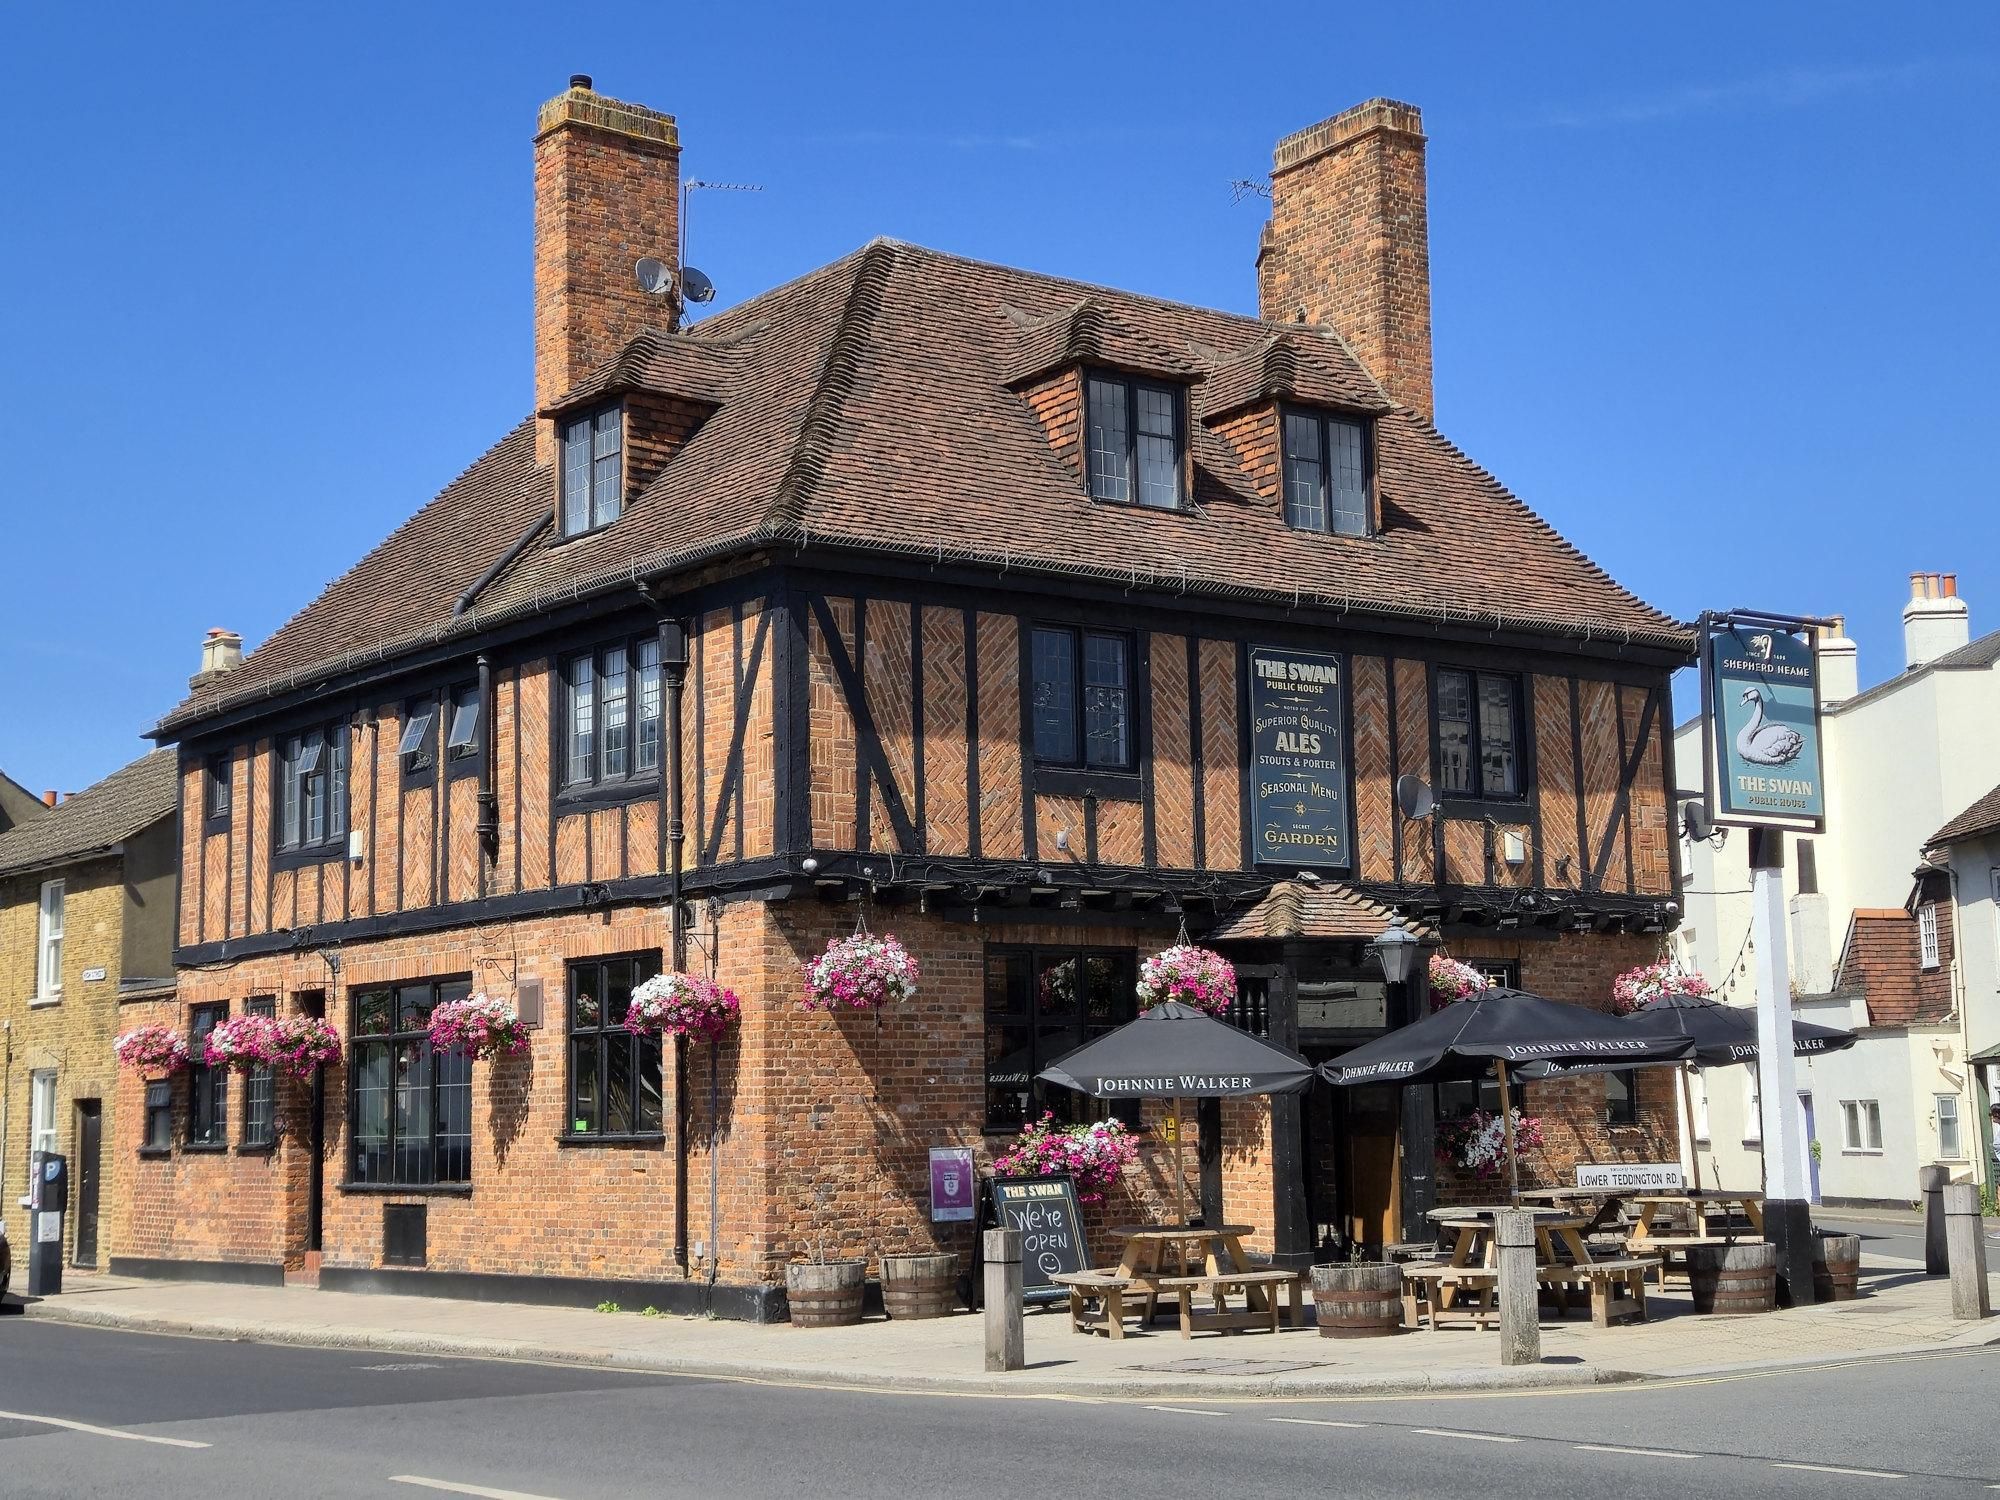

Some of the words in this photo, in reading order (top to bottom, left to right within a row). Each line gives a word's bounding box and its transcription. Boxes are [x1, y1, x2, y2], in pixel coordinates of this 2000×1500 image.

[1254, 658, 1287, 680] THE
[1288, 662, 1337, 685] SWAN
[1723, 660, 1774, 673] SHEPHERD
[1777, 665, 1810, 677] NEAME
[1266, 680, 1296, 691] PUBLIC
[1297, 683, 1324, 694] HOUSE
[1255, 716, 1298, 733] SUPERIOR
[1300, 714, 1338, 737] QUALITY
[1275, 731, 1321, 755] ALES
[1259, 755, 1292, 766] STOUTS
[1293, 758, 1301, 767] &
[1303, 758, 1336, 770] PORTER
[1260, 782, 1308, 798] SEASONAL
[1311, 781, 1338, 801] MENU
[1737, 775, 1766, 792] THE
[1768, 778, 1813, 796] SWAN
[1748, 796, 1777, 806] PUBLIC
[1779, 798, 1807, 809] HOUSE
[1264, 830, 1338, 847] GARDEN
[1506, 1043, 1580, 1059] JOHNNIE
[1580, 1040, 1648, 1051] WALKER
[1729, 1044, 1759, 1060] JOHN
[1793, 1038, 1826, 1051] ALKER
[1338, 1065, 1378, 1083] JOHNNIE
[1377, 1061, 1415, 1074] WALKER
[1095, 1078, 1174, 1096] JOHNNIE
[1179, 1075, 1252, 1089] WALKER
[1580, 1175, 1608, 1186] LOWER
[1612, 1173, 1662, 1186] TEDDINGTON
[1666, 1172, 1680, 1184] RD.
[1003, 1186, 1026, 1198] THE
[1028, 1183, 1063, 1197] SWAN
[1008, 1202, 1062, 1231] We're
[1024, 1232, 1067, 1251] OPEN
